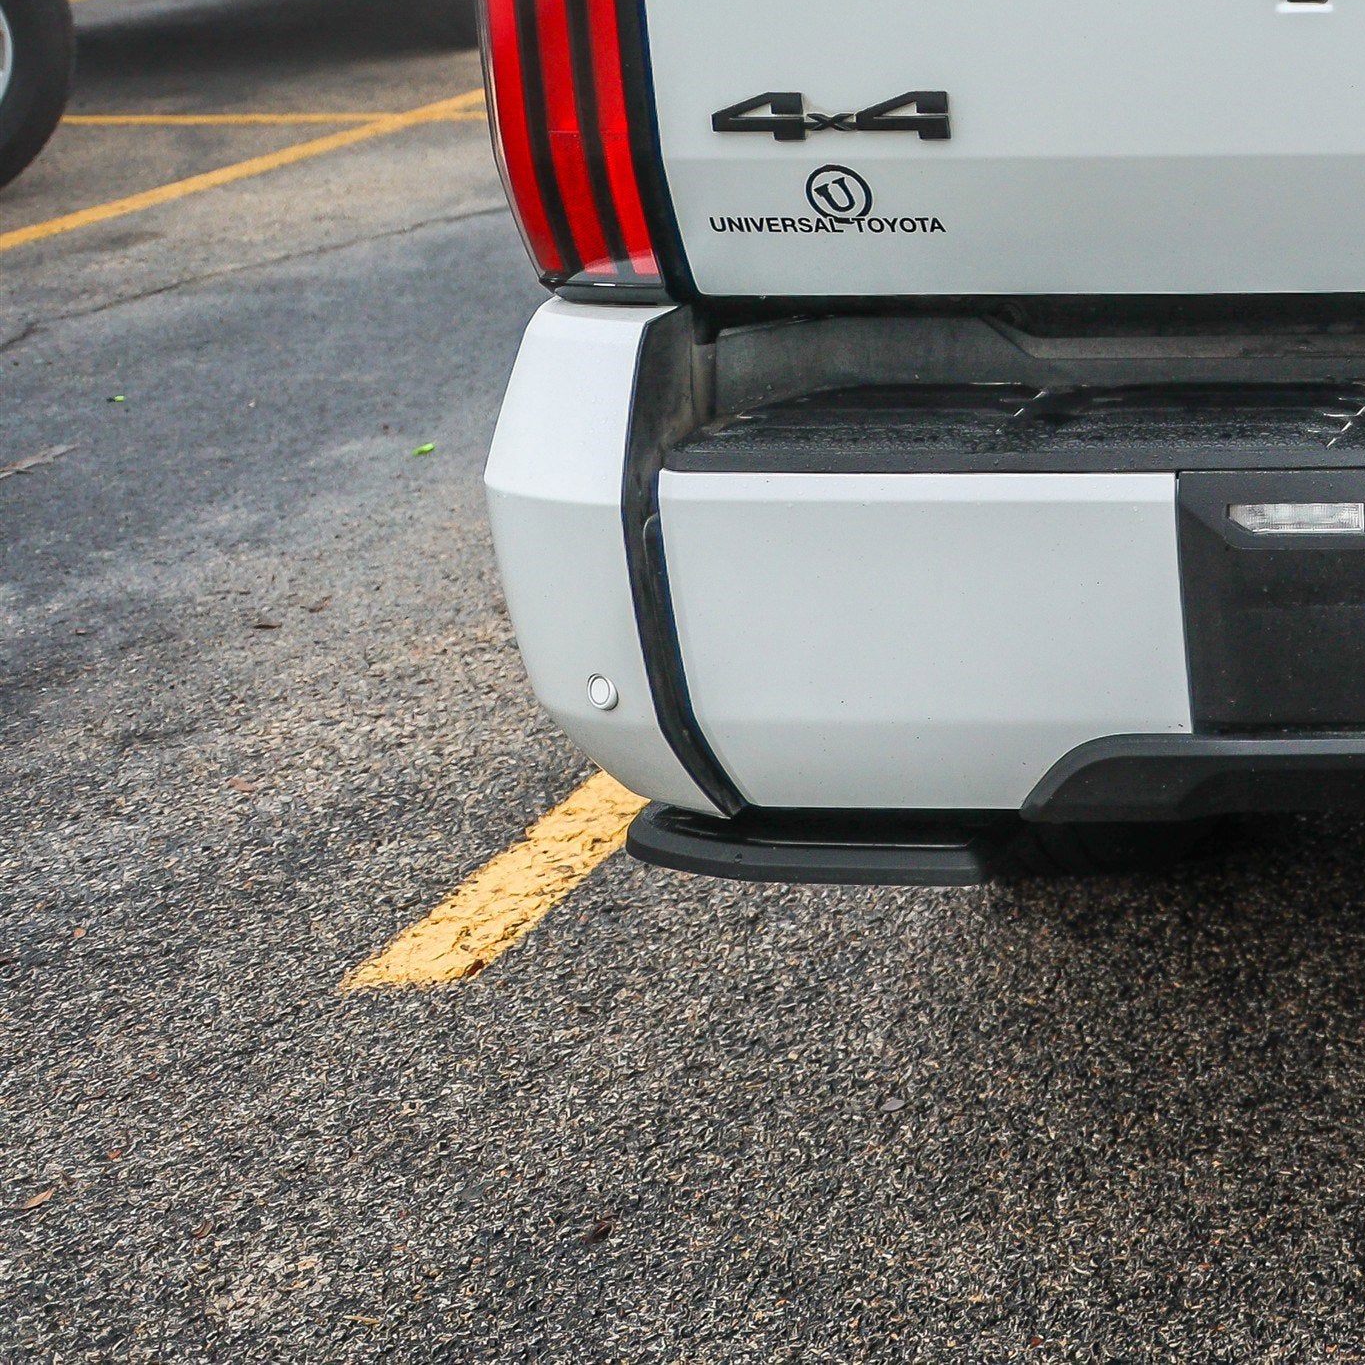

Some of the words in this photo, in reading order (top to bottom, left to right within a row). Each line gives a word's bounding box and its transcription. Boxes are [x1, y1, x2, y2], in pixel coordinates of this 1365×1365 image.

[711, 91, 951, 141] 4x4
[709, 216, 844, 233] UNIVERSAL
[851, 216, 947, 233] TOYOTA
